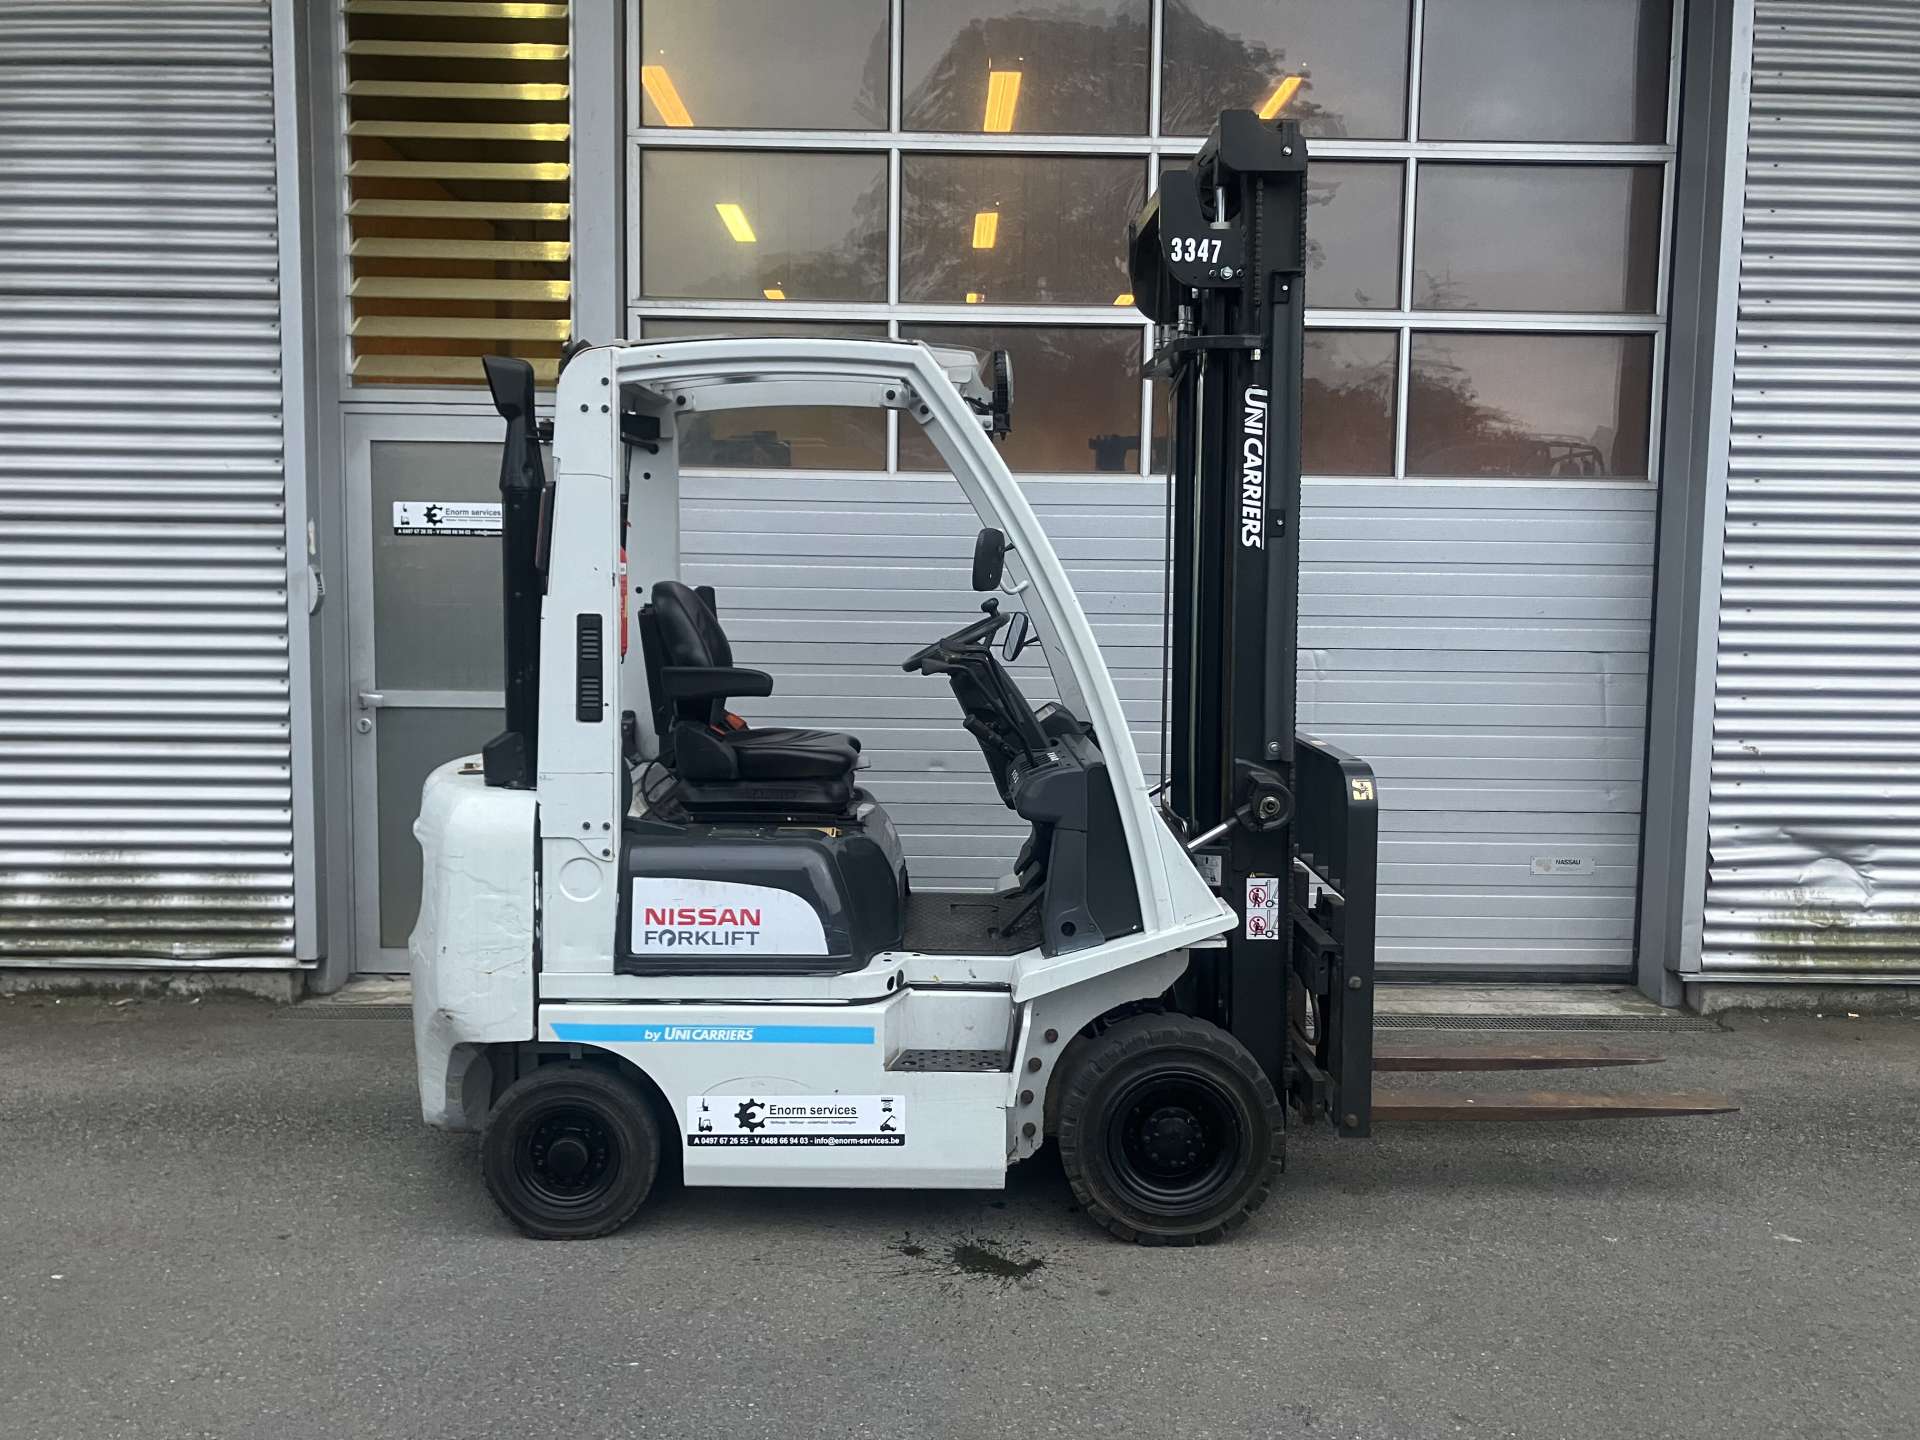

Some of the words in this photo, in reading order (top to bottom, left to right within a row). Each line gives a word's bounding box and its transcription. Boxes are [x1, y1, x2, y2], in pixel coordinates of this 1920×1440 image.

[1170, 237, 1222, 263] 3347
[1241, 385, 1268, 550] UNICARRIERS
[445, 508, 469, 516] Enorm
[471, 508, 501, 516] services
[645, 908, 761, 926] NISSAN
[644, 929, 760, 947] FORKLIFT
[644, 1029, 661, 1042] by
[664, 1027, 755, 1041] UNICARRIERS
[769, 1104, 806, 1115] Enorm
[810, 1104, 857, 1115] services
[814, 1137, 900, 1145] info@enorm-services.be
